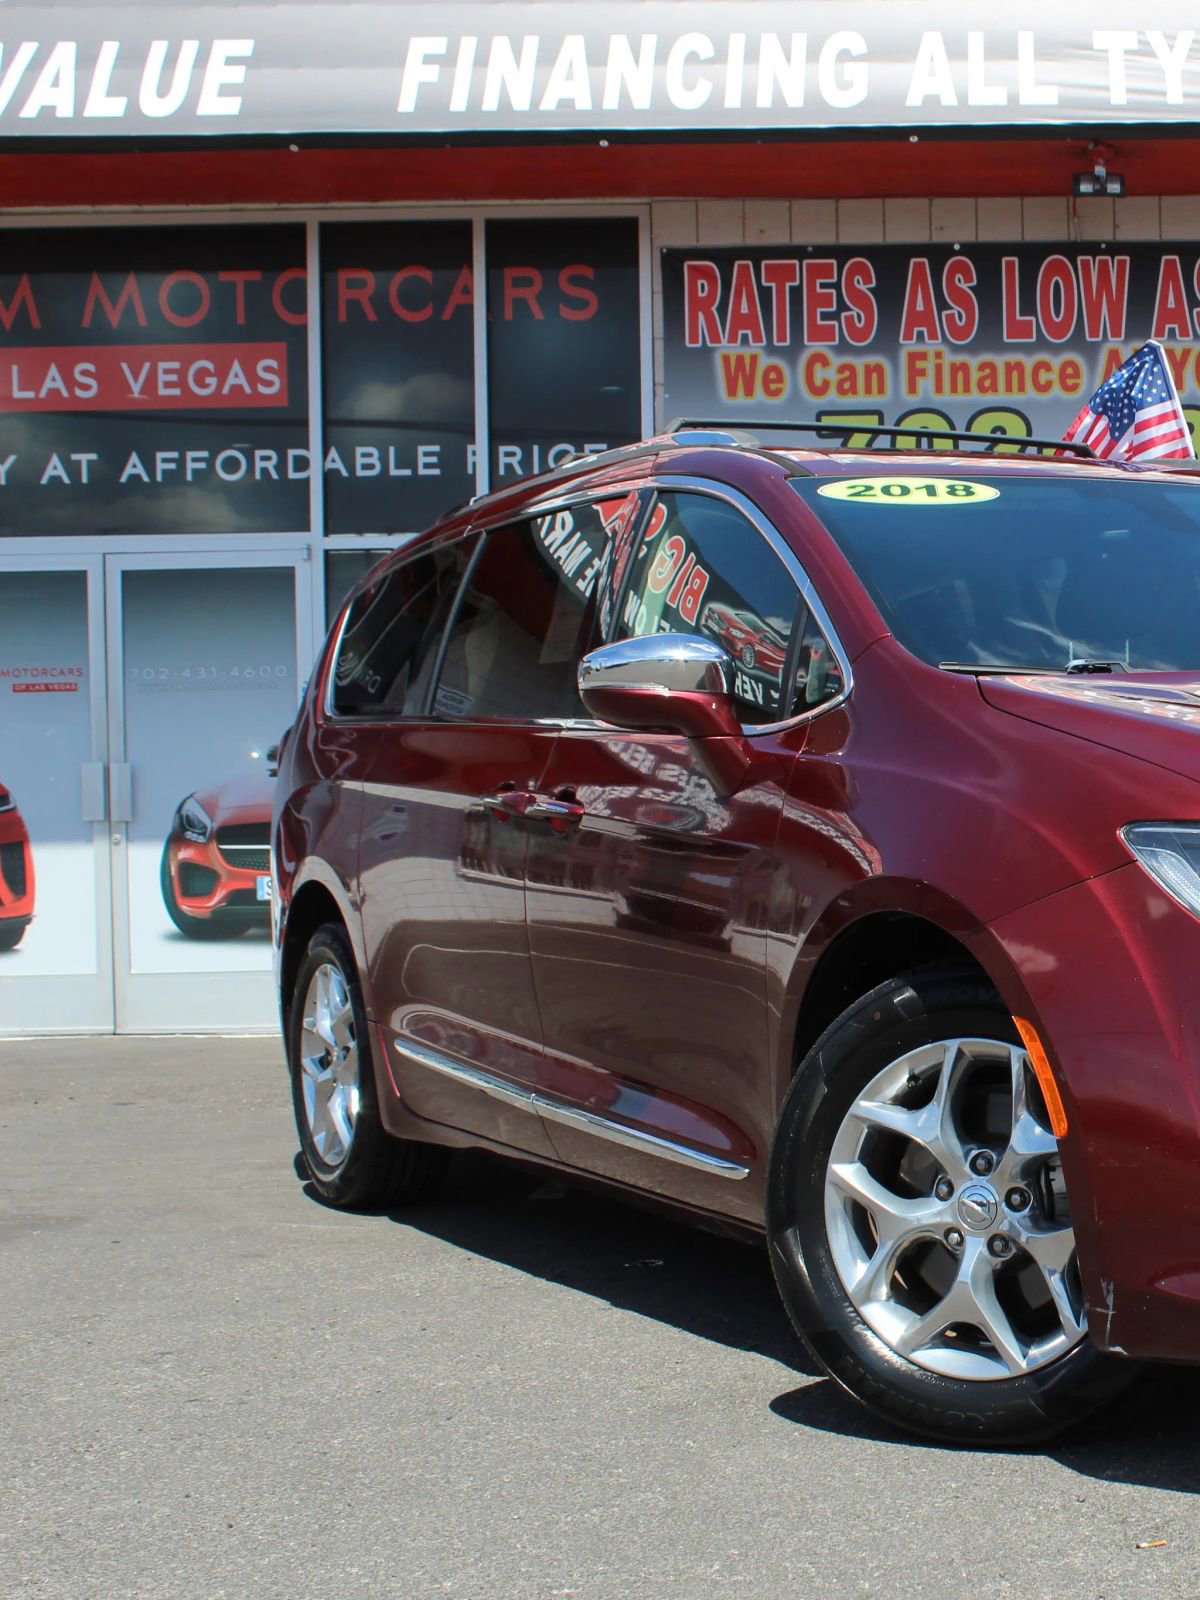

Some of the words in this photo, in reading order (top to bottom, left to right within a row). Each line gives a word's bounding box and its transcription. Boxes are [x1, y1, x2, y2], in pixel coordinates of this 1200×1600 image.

[0, 39, 255, 118] VALUE
[397, 31, 869, 113] FINANCING
[905, 30, 1059, 107] ALL
[80, 264, 599, 331] MOTORCARS
[684, 257, 878, 347] RATES
[899, 256, 979, 345] AS
[1001, 254, 1130, 343] LOW
[11, 361, 99, 399] LAS
[120, 358, 282, 397] VEGAS
[721, 350, 786, 400] We
[803, 348, 886, 397] Can
[906, 345, 1083, 396] Finance
[40, 452, 99, 485] AT
[119, 444, 441, 484] AFFORDABLE
[845, 482, 976, 498] 2018
[0, 667, 84, 678] MOTORCARS
[47, 682, 77, 691] VEGAS
[128, 665, 288, 681] 702-431-4600
